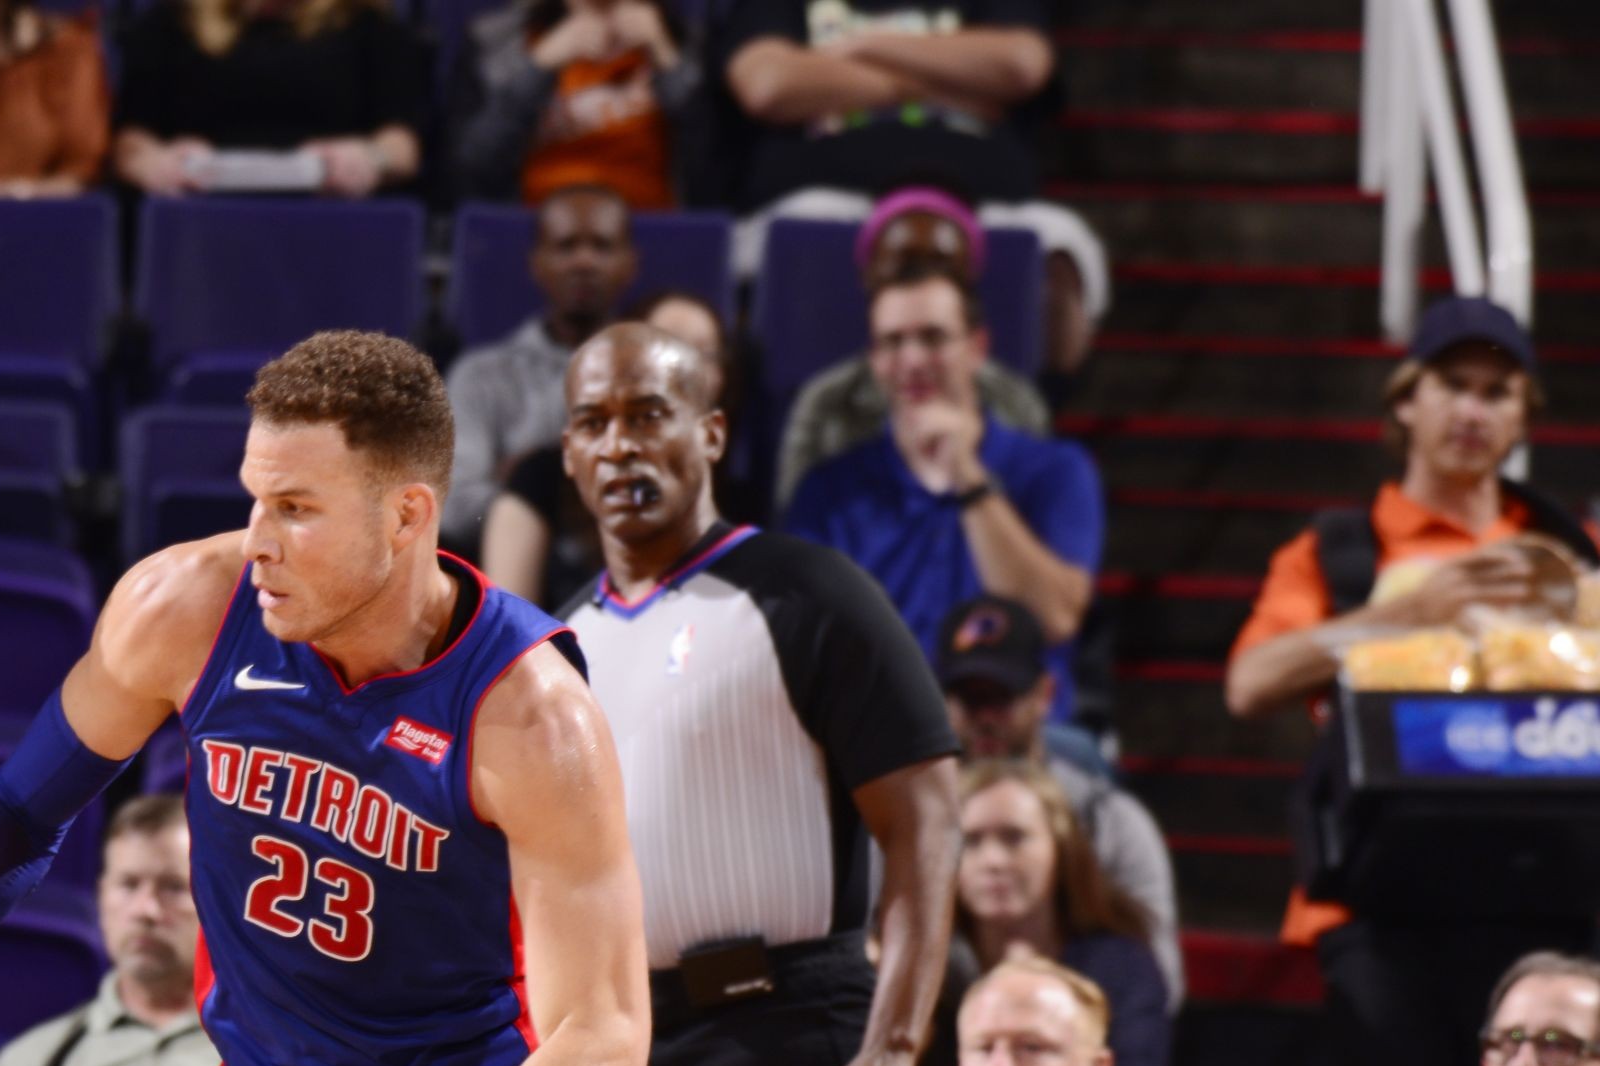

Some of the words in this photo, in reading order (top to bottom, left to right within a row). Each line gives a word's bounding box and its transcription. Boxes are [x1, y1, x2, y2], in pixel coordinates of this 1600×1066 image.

[394, 720, 448, 750] Flagstar
[202, 739, 450, 872] DETROIT
[244, 835, 375, 962] 23
